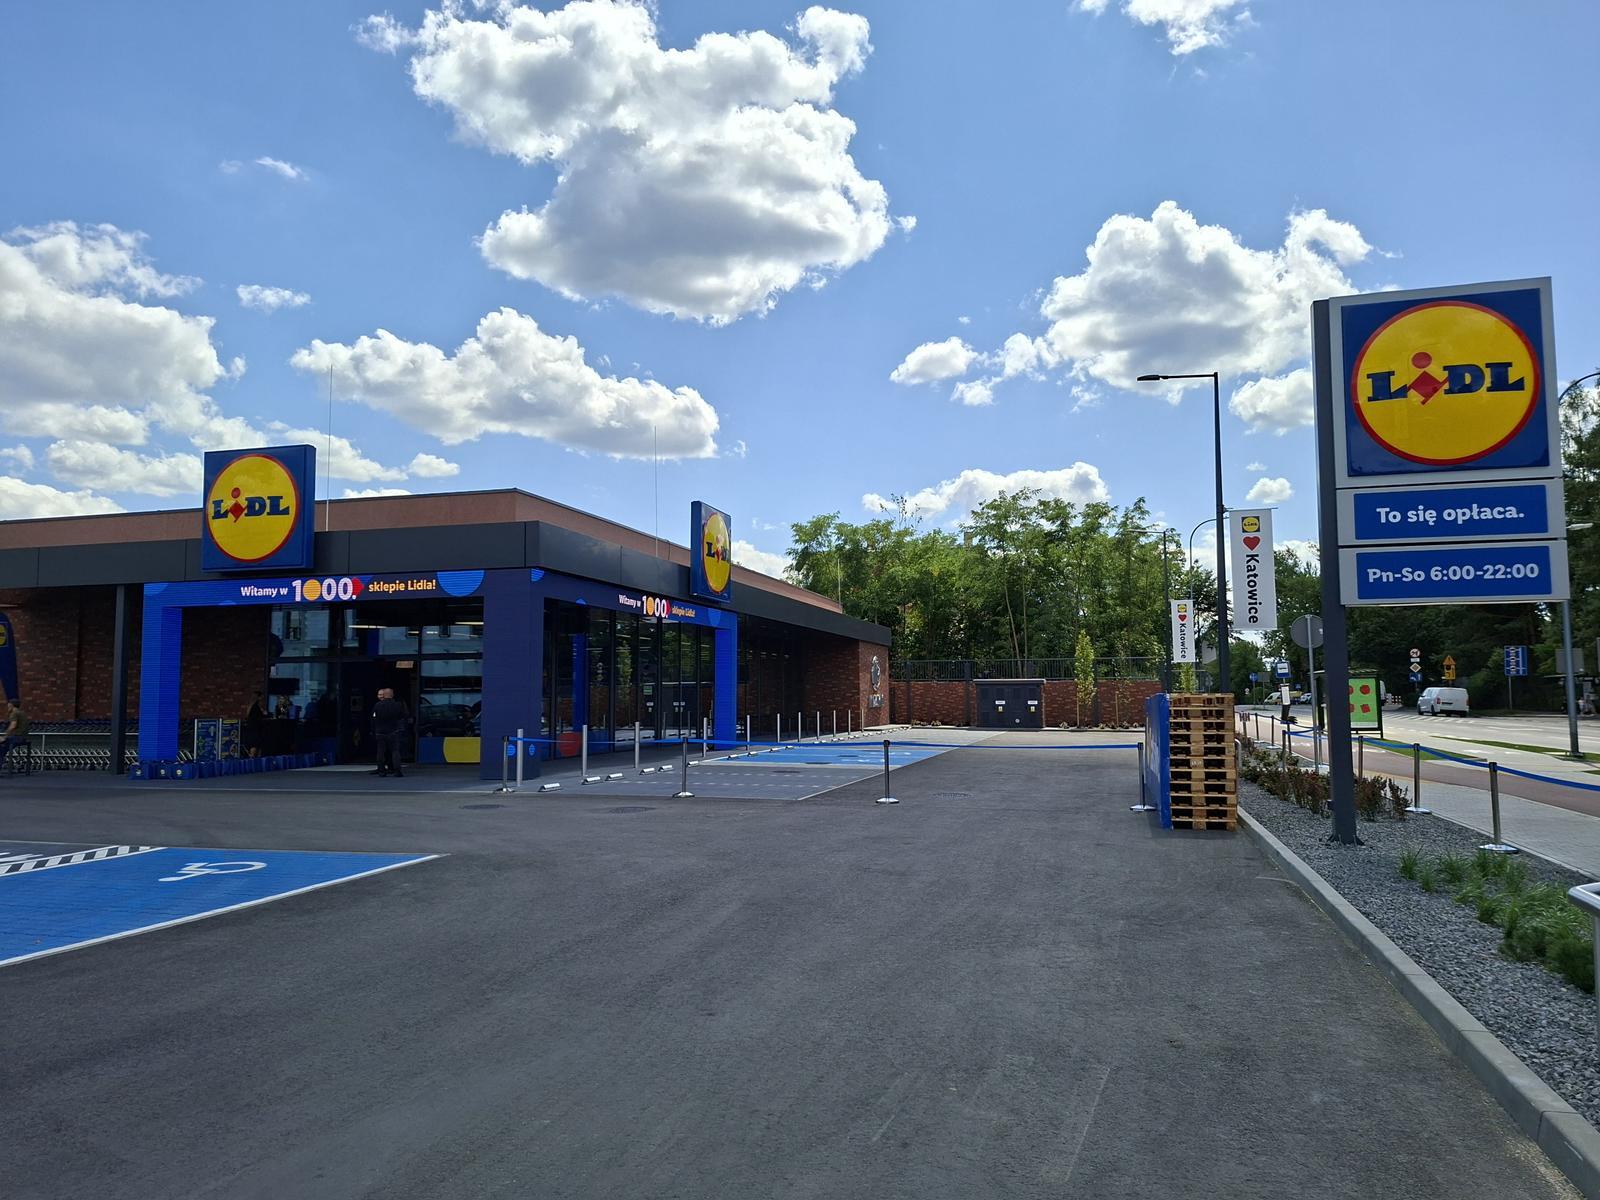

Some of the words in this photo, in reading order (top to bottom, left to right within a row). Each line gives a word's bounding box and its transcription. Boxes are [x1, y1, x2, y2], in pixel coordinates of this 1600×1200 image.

[1376, 507, 1401, 523] To
[1407, 505, 1437, 525] się
[1443, 504, 1525, 524] opłaca.
[1367, 567, 1425, 582] Pn-So
[1430, 563, 1539, 581] 6:00-22:00
[240, 585, 278, 598] Witamy
[279, 586, 288, 595] w
[368, 581, 405, 594] sklepie
[407, 579, 436, 591] Lidla!
[1245, 553, 1262, 624] Katowice
[1179, 623, 1188, 659] Katowice
